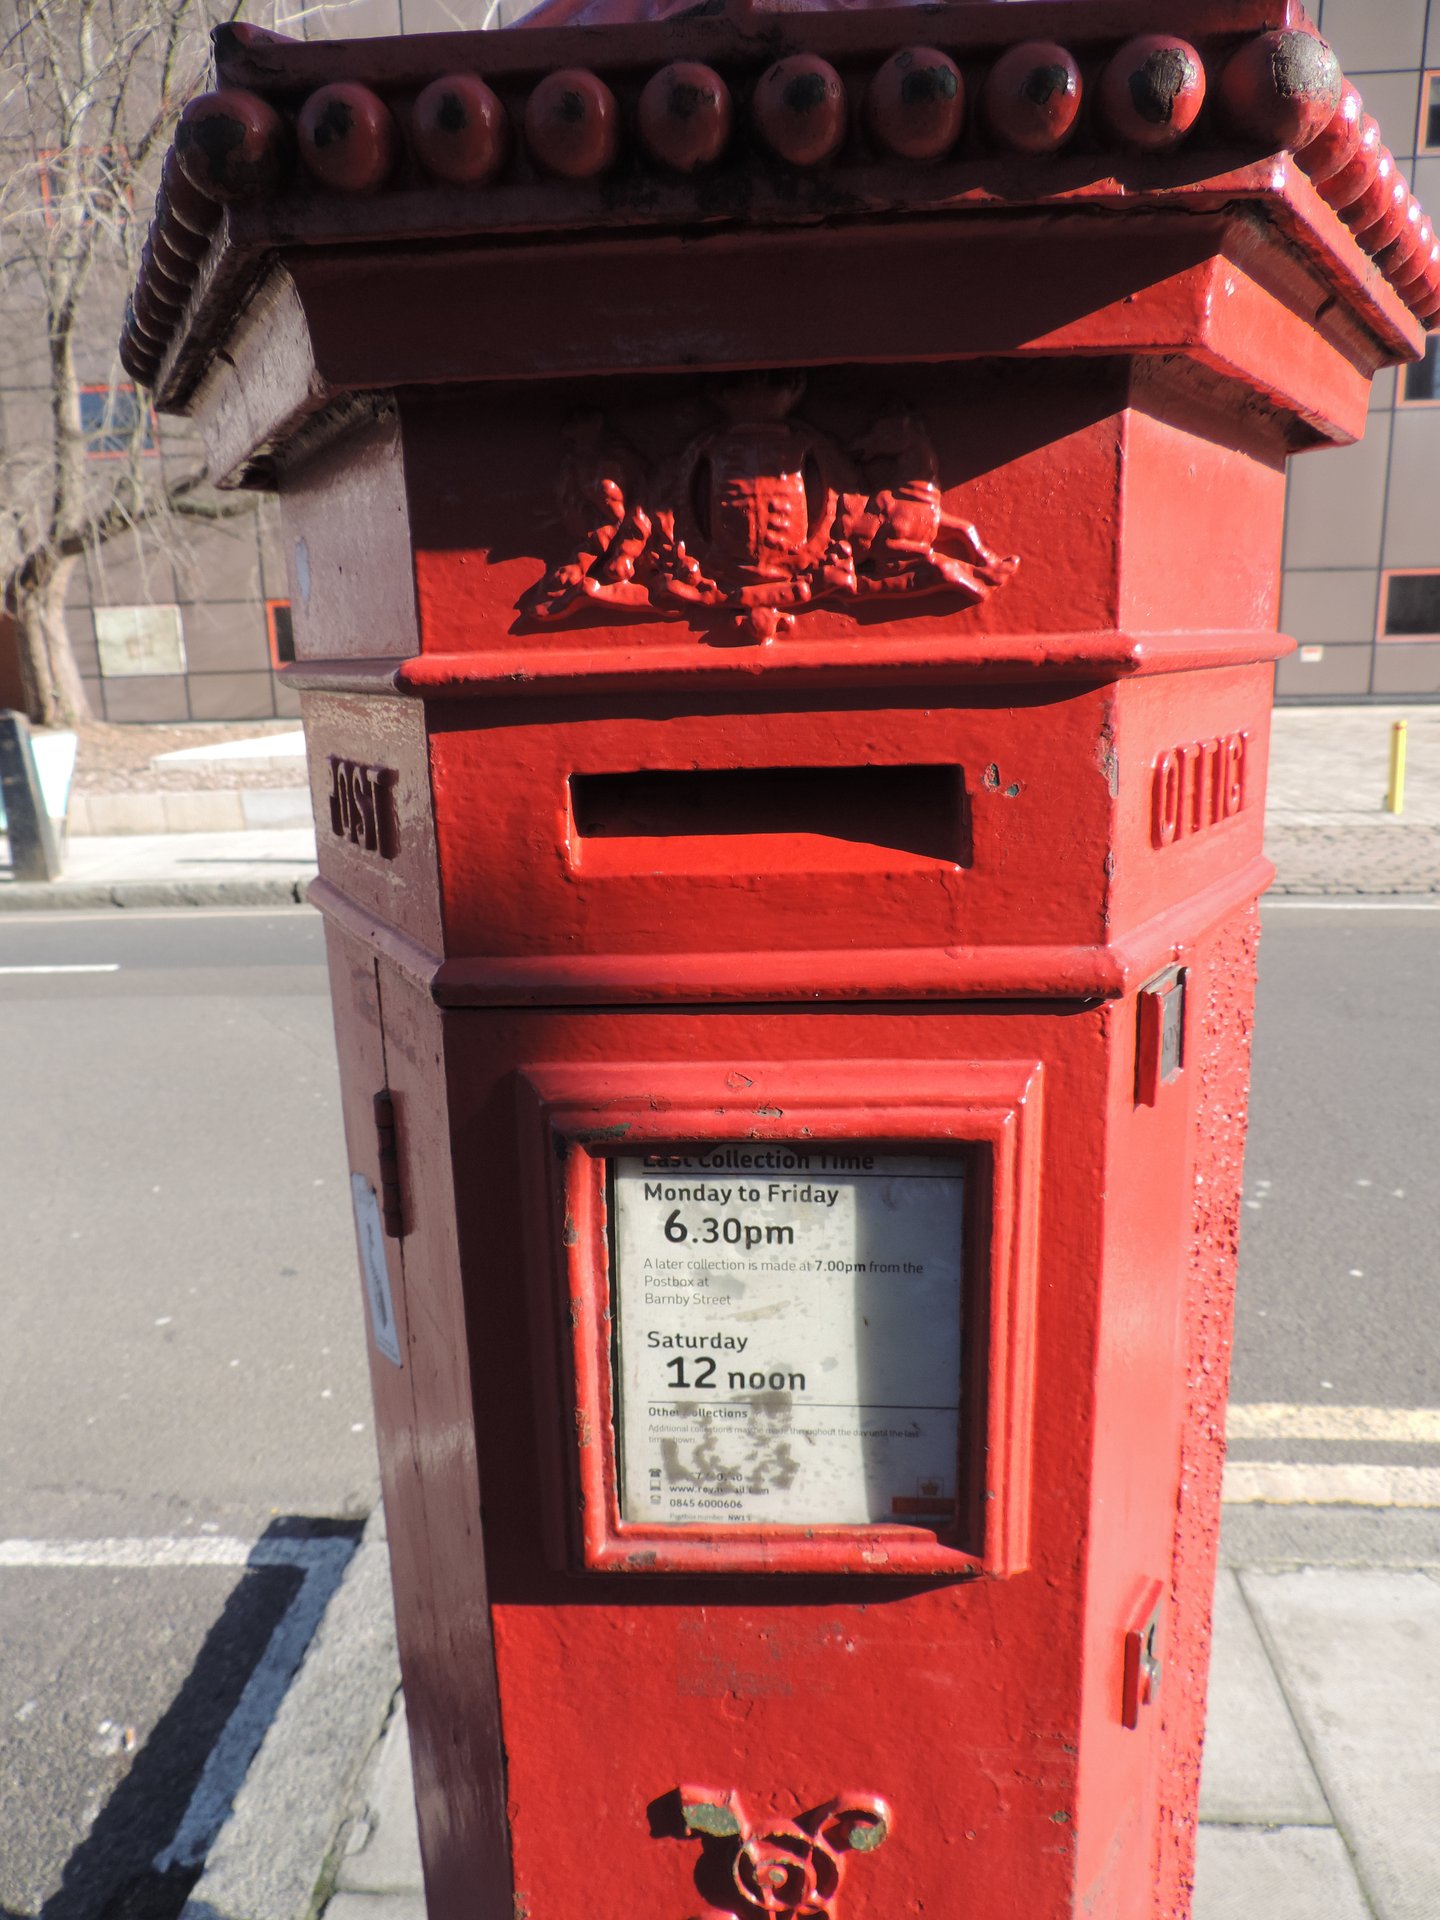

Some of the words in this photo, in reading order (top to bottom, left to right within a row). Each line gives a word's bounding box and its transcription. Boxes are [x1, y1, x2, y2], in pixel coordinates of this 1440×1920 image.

[699, 1149, 809, 1169] Collection
[644, 1183, 732, 1205] Monday
[738, 1186, 760, 1202] to
[768, 1185, 839, 1207] Friday
[664, 1209, 794, 1250] 6.30pm
[644, 1258, 653, 1269] A
[655, 1259, 684, 1269] later
[687, 1259, 745, 1270] collection
[748, 1259, 758, 1270] is
[761, 1260, 796, 1271] made
[800, 1262, 811, 1271] at
[815, 1260, 866, 1274] 7.00pm
[869, 1261, 900, 1273] from
[903, 1262, 924, 1274] the
[644, 1275, 694, 1287] Postbox
[697, 1277, 709, 1287] at
[645, 1293, 690, 1306] Barnby
[693, 1293, 731, 1305] Street
[647, 1331, 748, 1352] Saturday
[666, 1356, 717, 1389] 12
[727, 1371, 806, 1391] noon
[686, 1408, 748, 1418] ollections
[669, 1498, 695, 1508] 0845
[697, 1499, 743, 1509] 6000606
